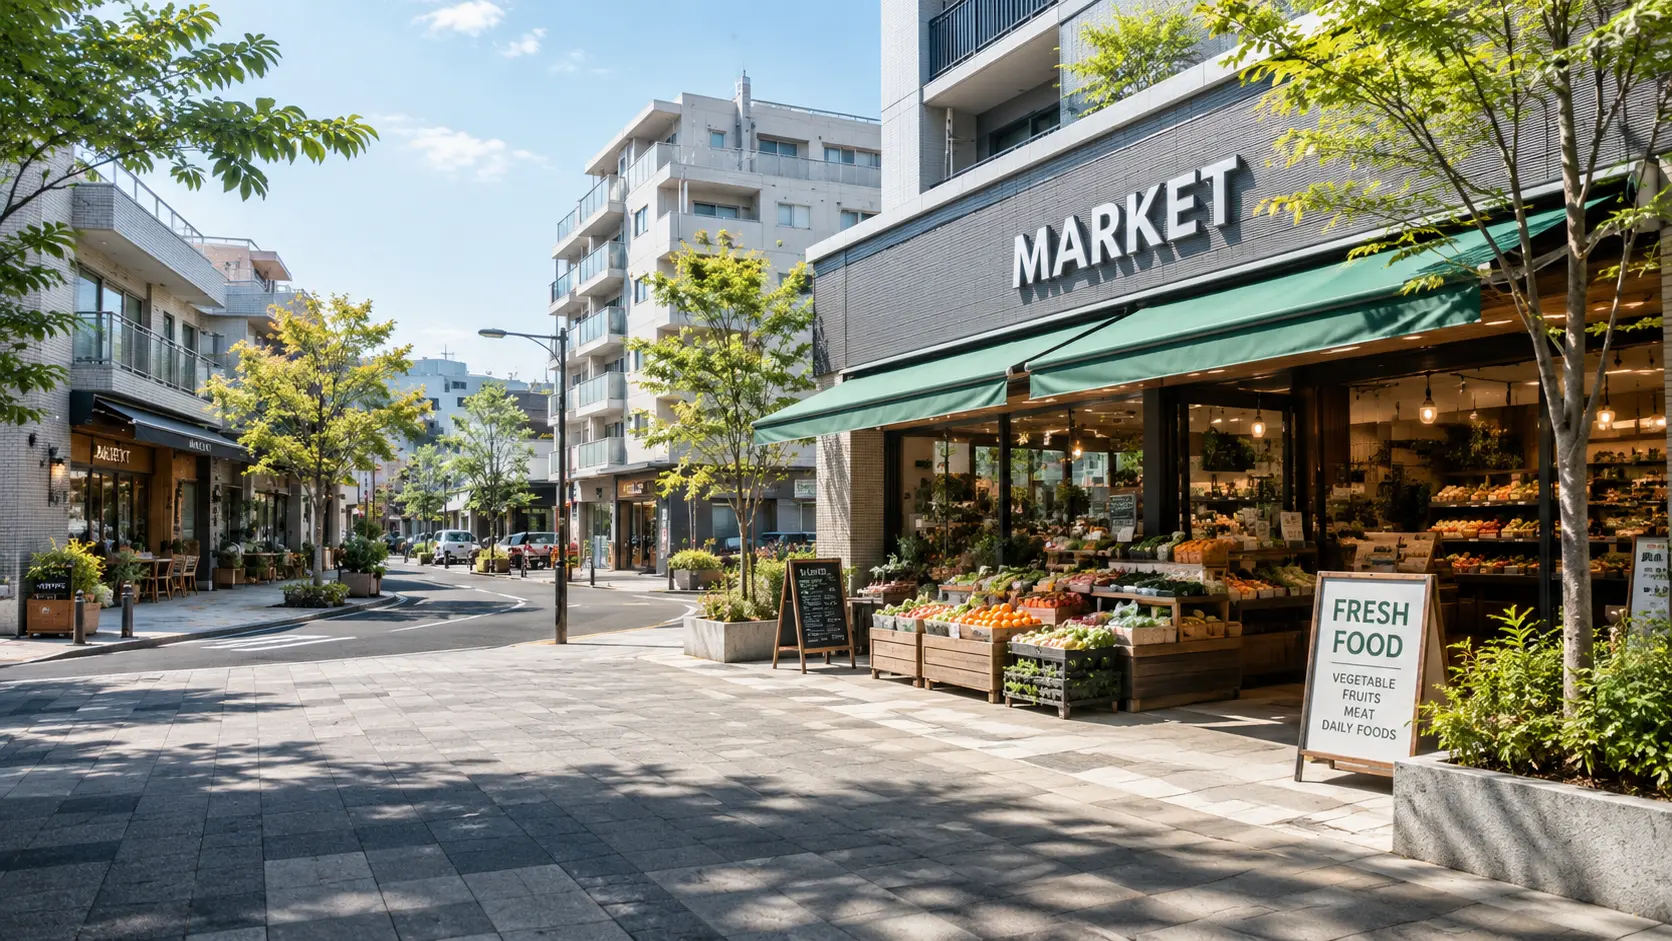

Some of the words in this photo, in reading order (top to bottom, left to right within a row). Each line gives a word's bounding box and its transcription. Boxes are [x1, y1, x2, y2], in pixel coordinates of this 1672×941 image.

[1013, 154, 1240, 288] MARKET
[1333, 599, 1409, 626] FRESH
[1333, 630, 1403, 657] FOOD
[1332, 673, 1395, 689] VEGETABLE
[1342, 689, 1381, 704] FRUITS
[1344, 706, 1375, 720] MEAT
[1321, 719, 1353, 734] DAILY
[1357, 724, 1396, 740] FOODS
